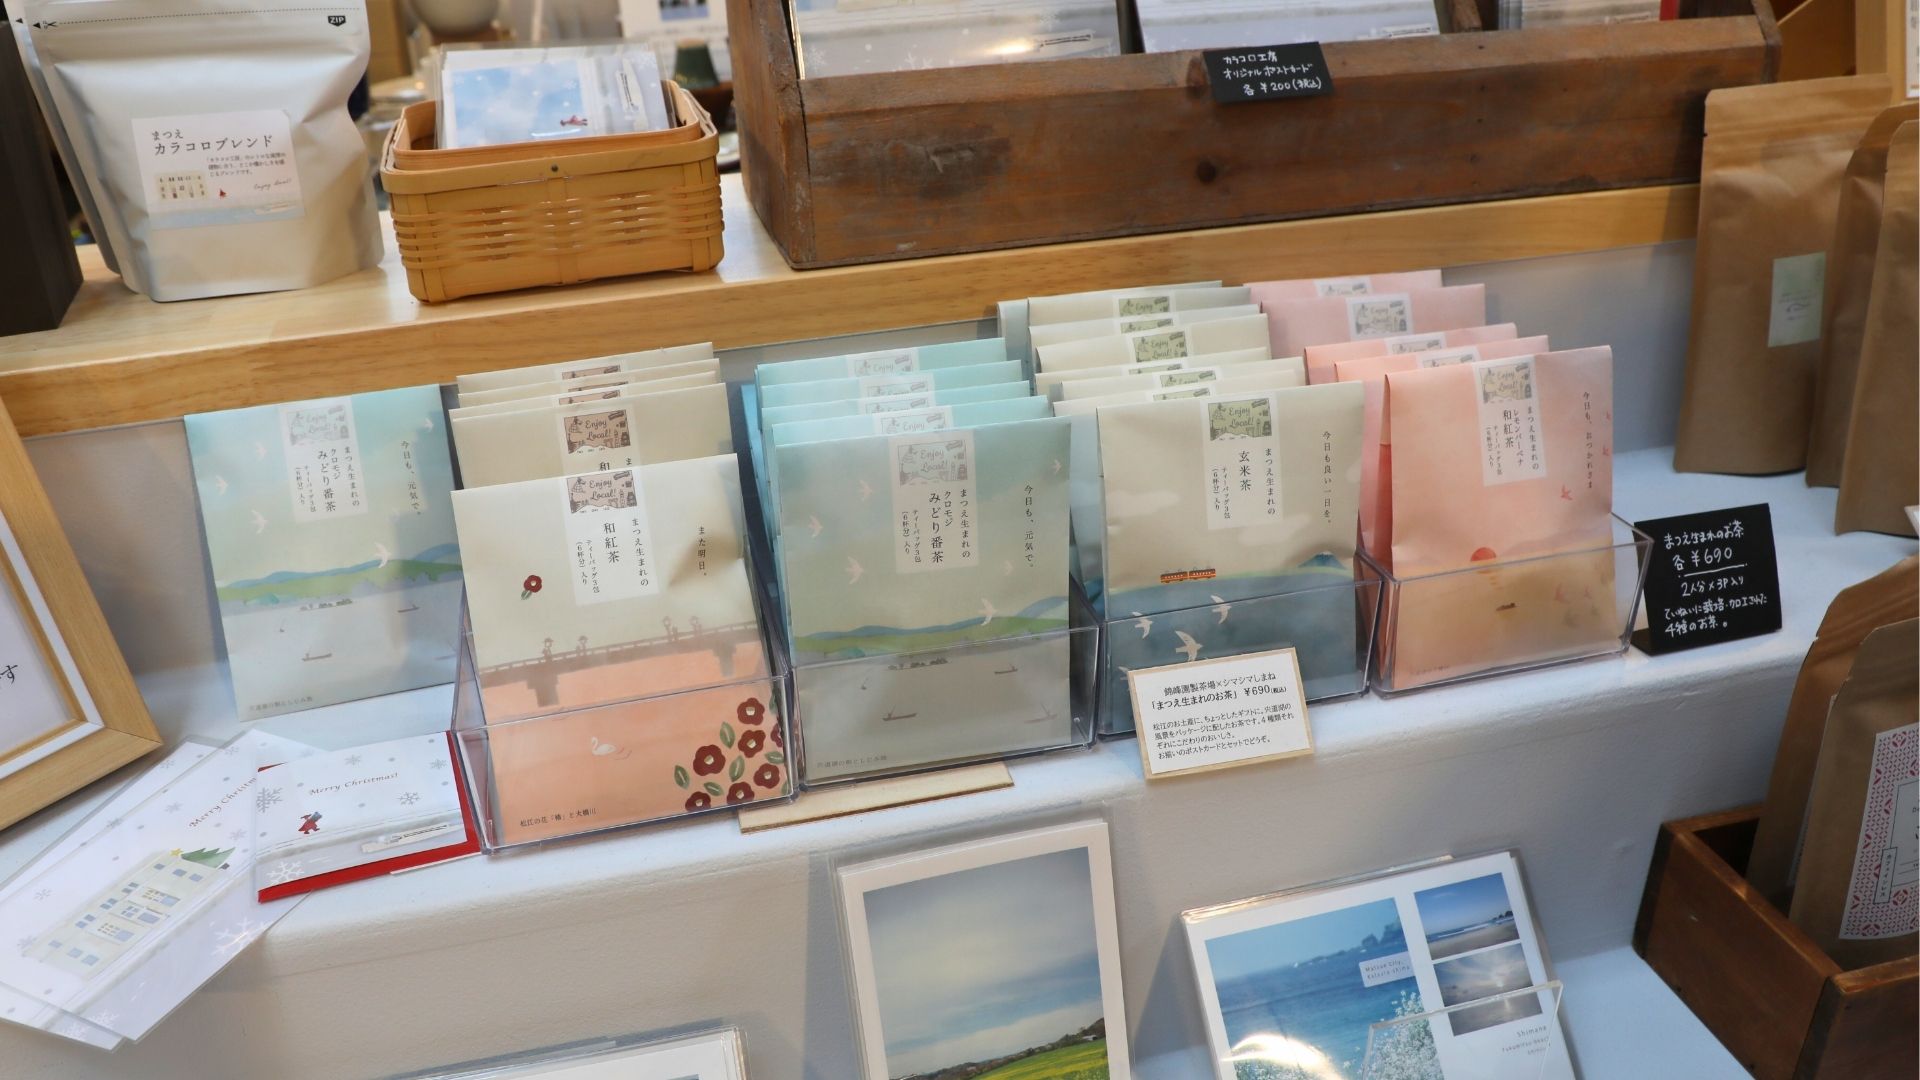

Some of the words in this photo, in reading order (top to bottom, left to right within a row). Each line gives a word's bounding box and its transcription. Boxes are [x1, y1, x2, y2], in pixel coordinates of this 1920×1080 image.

[330, 16, 345, 24] ZIP
[1222, 50, 1278, 64] カラコロ工房
[1243, 83, 1255, 96] 各
[152, 129, 184, 141] まつえ
[154, 134, 273, 156] カラコロブレンド
[585, 420, 607, 430] Enjoy
[1228, 407, 1251, 419] Enjoy
[1230, 418, 1254, 428] Local!
[587, 429, 612, 441] Local!
[1503, 410, 1514, 449] 和紅茶
[1514, 409, 1524, 466] レモンバーベナ
[1528, 406, 1539, 470] まつえ生まれの
[1582, 391, 1594, 489] 今日も、おつかれさま
[331, 448, 340, 480] クロモジ
[920, 450, 944, 461] Enjoy
[318, 450, 336, 512] みどり番茶
[345, 446, 360, 506] まつえ生まれの
[401, 440, 421, 516] 今日も、元気で。
[589, 479, 613, 490] Enjoy
[1238, 450, 1252, 492] 玄米茶
[1265, 448, 1276, 515] まつえ生まれの
[1322, 431, 1332, 524] 今日も良い一日を。
[590, 488, 617, 501] Local!
[944, 490, 952, 527] クロモジ
[913, 510, 922, 563] ティーバッグ3包
[928, 492, 944, 564] みどり番茶
[960, 488, 970, 558] まつえ生まれの
[1024, 484, 1035, 568] 今日も、元気で。
[1664, 520, 1744, 550] まつえ生まれのお茶
[604, 522, 621, 564] 和紅茶
[632, 518, 649, 586] まつえ生まれの
[698, 526, 708, 576] また明日。
[1672, 554, 1685, 571] 各
[1692, 547, 1733, 568] ¥690
[1665, 615, 1728, 638] 4種のお茶。
[1151, 690, 1238, 711] 「まつえ生まれのお茶」
[1157, 732, 1236, 750] ぞれにこだわりのおいしさ。
[1158, 735, 1271, 760] お揃いのポストカードとセットでどうぞ。
[308, 784, 342, 796] Merry
[344, 772, 400, 788] Christmas!
[189, 805, 222, 827] Merry
